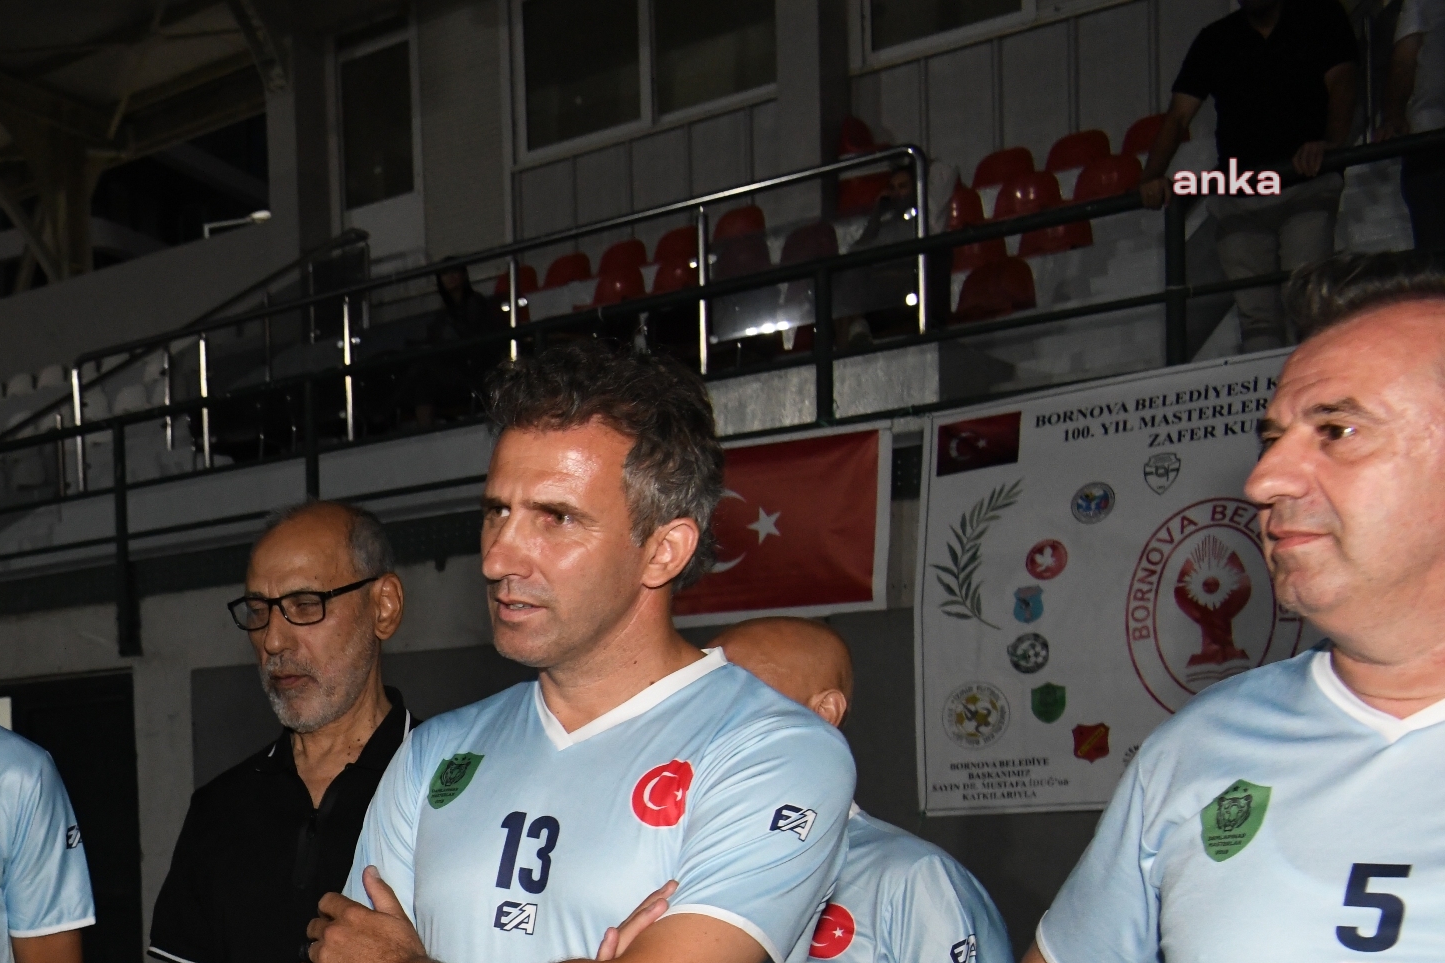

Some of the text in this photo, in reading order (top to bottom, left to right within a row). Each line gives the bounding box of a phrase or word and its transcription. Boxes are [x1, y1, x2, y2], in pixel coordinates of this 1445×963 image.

[1035, 402, 1129, 428] BORNOVA
[1135, 376, 1258, 412] BELEDİYESİ
[1063, 397, 1268, 443] 100. YIL MASTERLER
[1148, 418, 1259, 448] ZAFER KU
[1131, 515, 1198, 641] BORNOVA
[950, 757, 1049, 771] BORNOVA BELEDİYE
[495, 810, 560, 894] 13
[1335, 862, 1412, 953] 5
